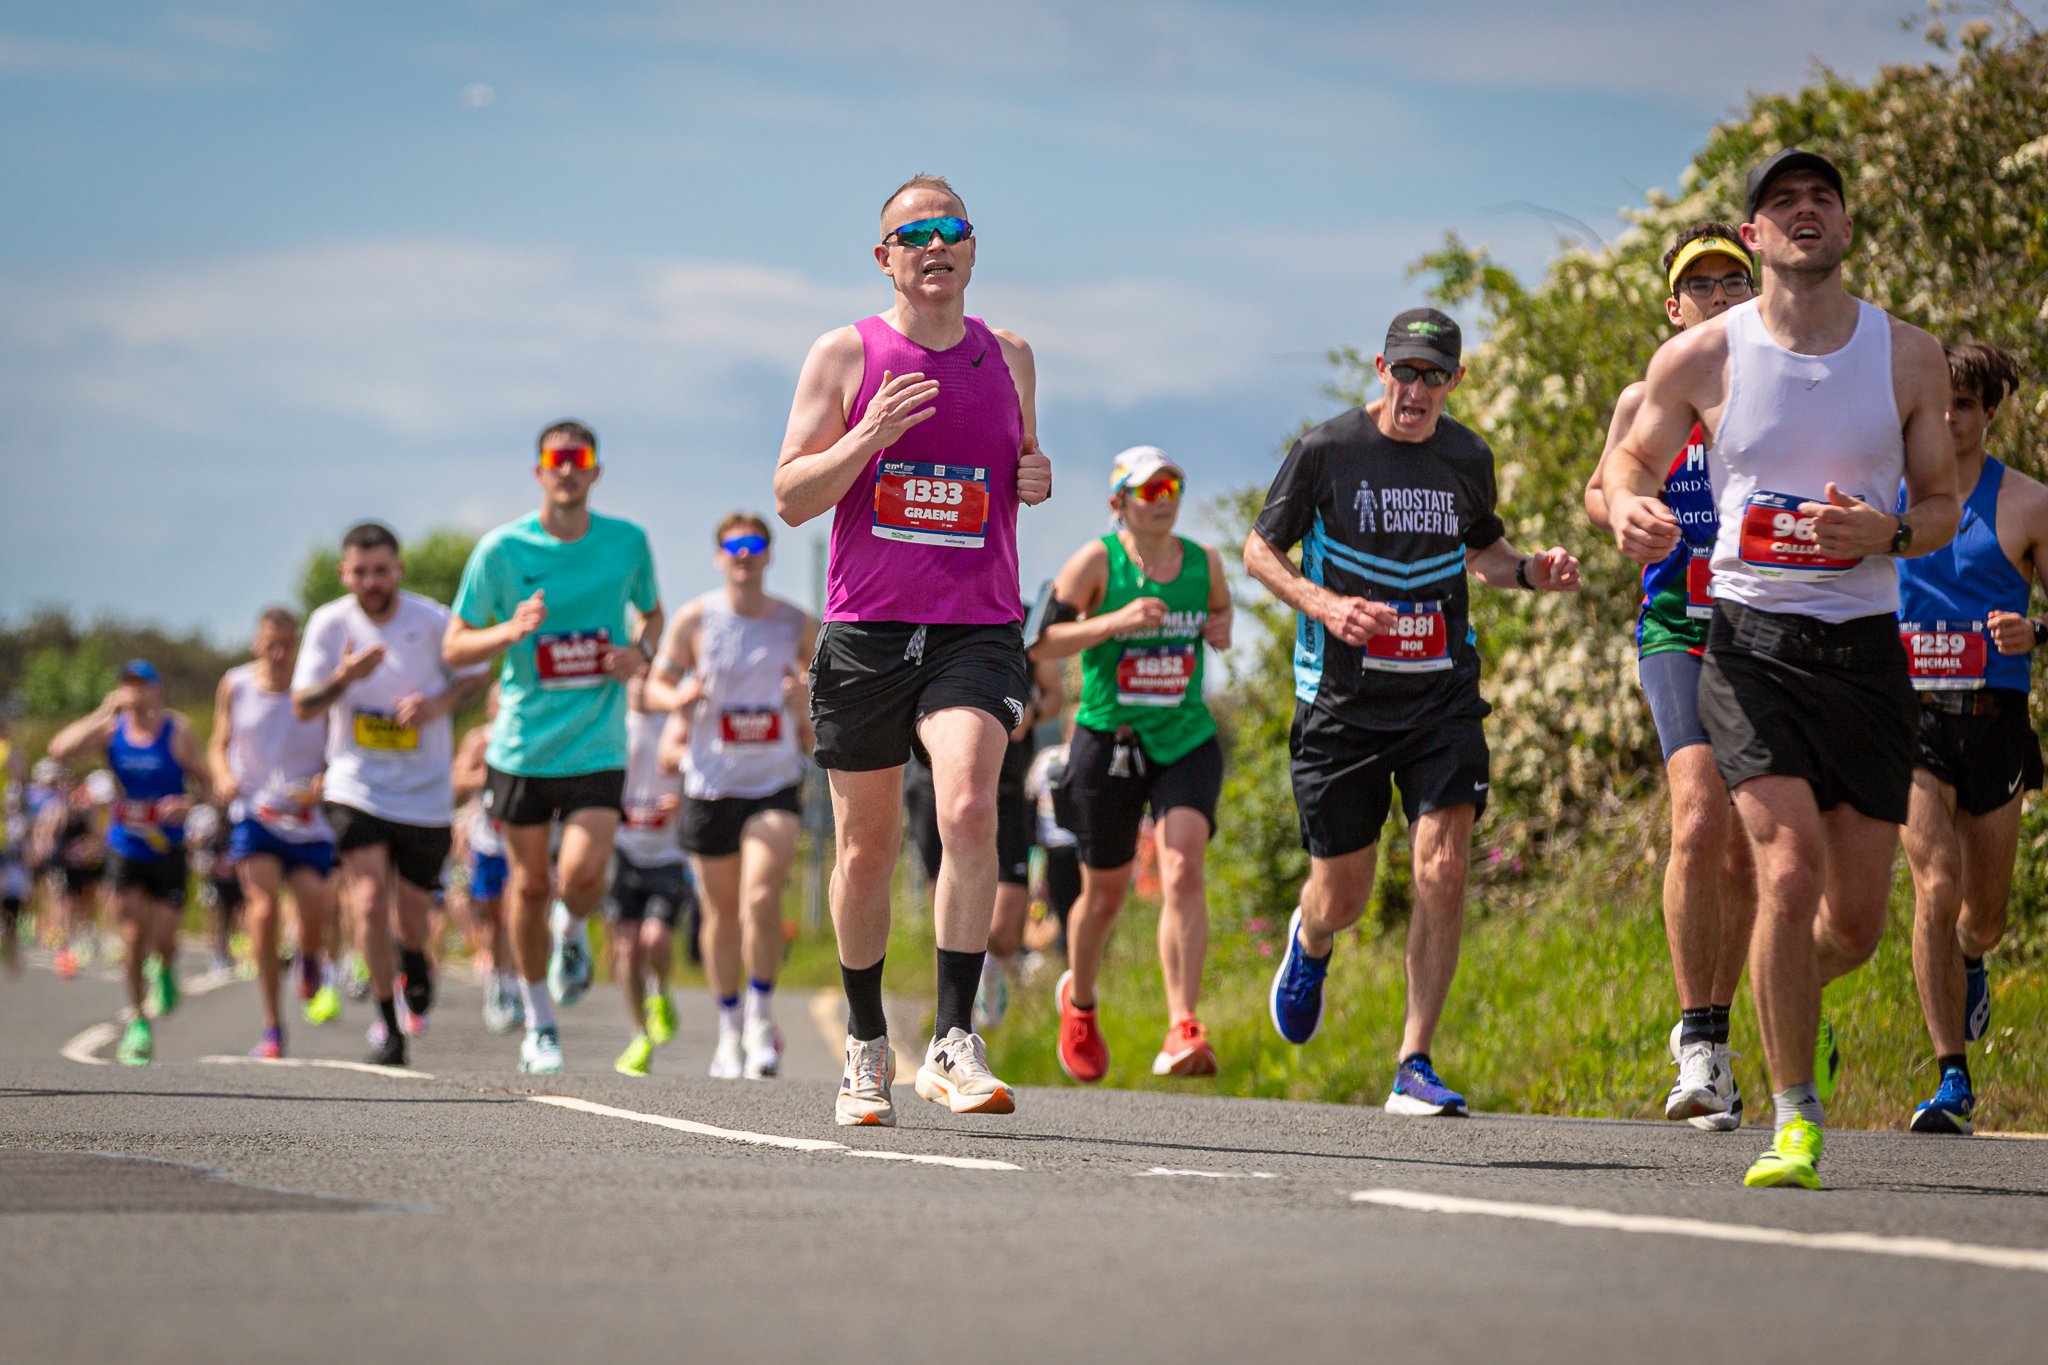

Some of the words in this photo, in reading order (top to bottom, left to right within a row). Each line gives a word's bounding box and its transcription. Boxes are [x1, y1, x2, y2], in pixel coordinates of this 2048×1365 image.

[1687, 444, 1704, 471] M
[903, 479, 963, 505] 1333
[1667, 476, 1711, 493] ORD'S
[1381, 488, 1455, 514] PROSTATE
[904, 507, 959, 522] GRAEME
[1383, 510, 1442, 534] CANCER
[1444, 513, 1459, 537] UK
[1773, 513, 1816, 540] 96
[1770, 541, 1819, 555] CALLU
[1305, 615, 1315, 653] ANCER
[1401, 640, 1424, 651] ROB
[1910, 633, 1966, 655] 1259
[1914, 657, 1961, 669] MICHAEL
